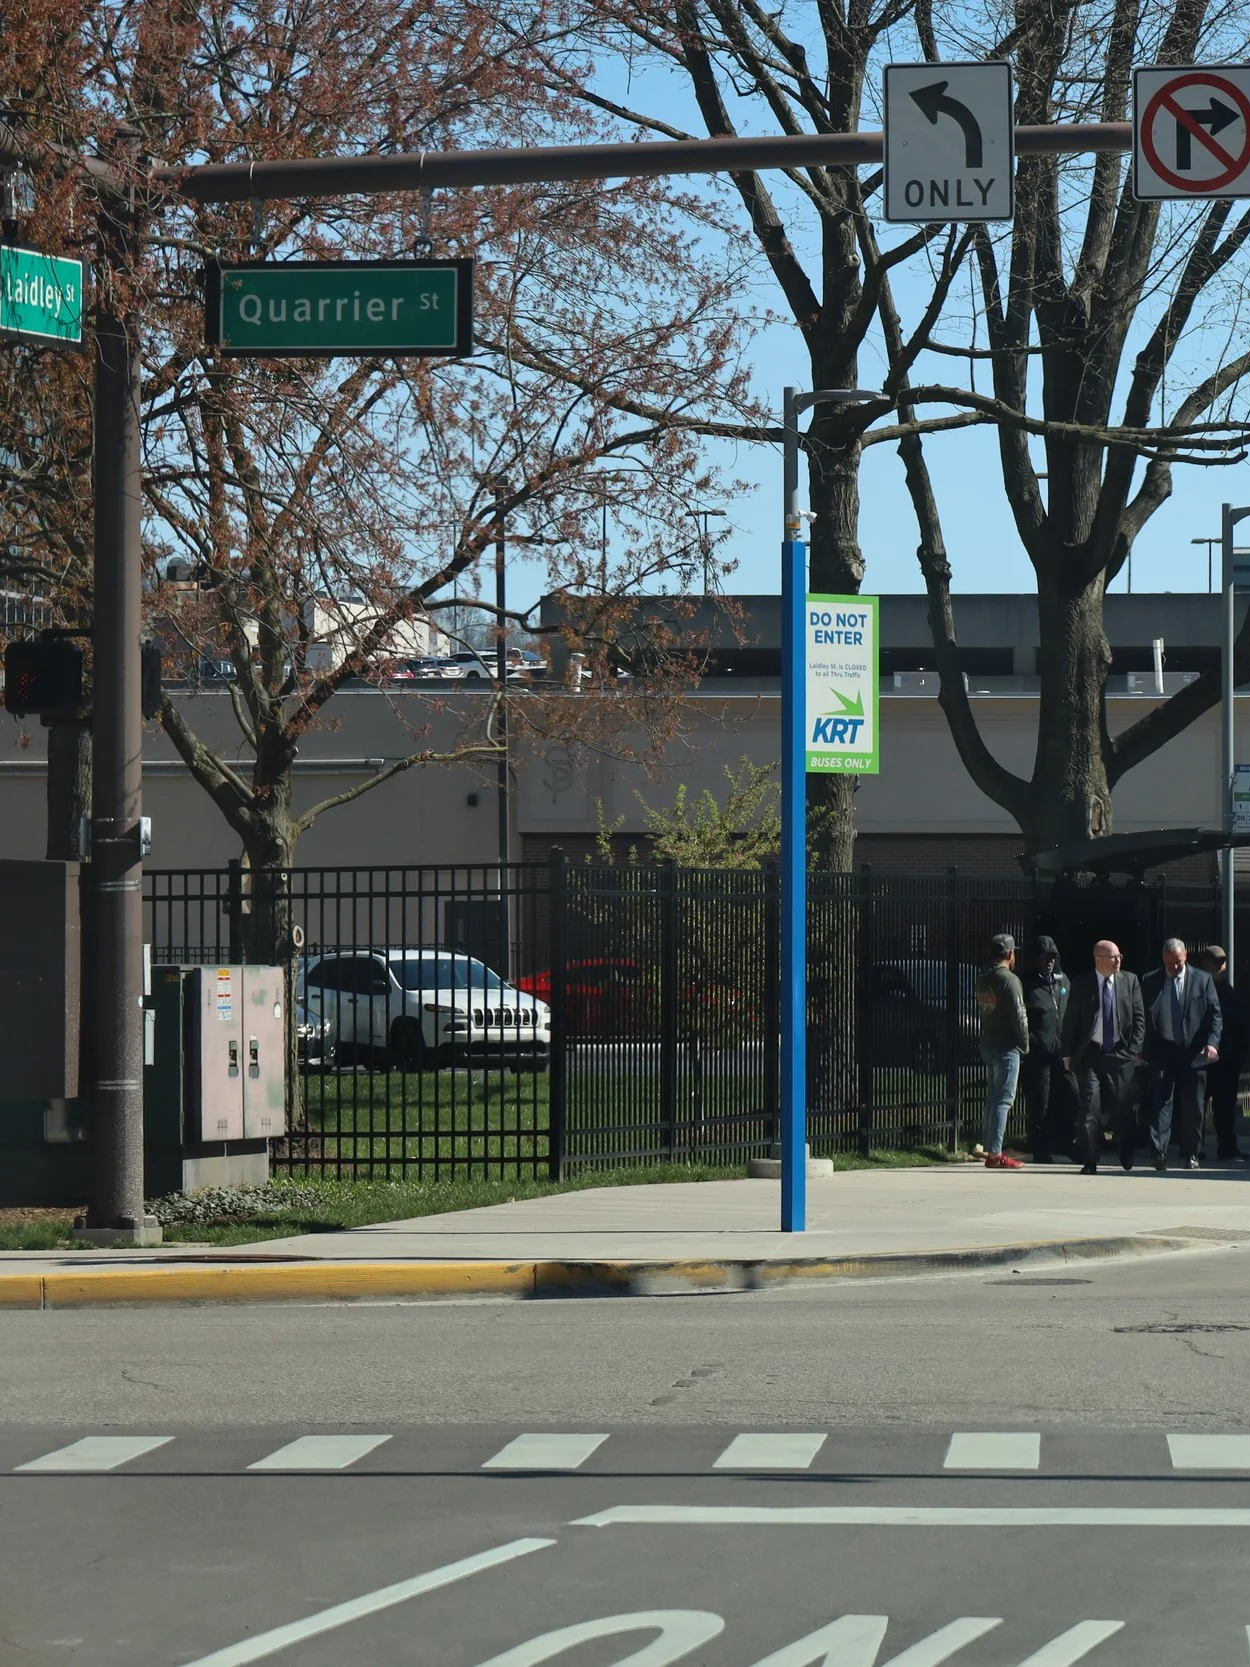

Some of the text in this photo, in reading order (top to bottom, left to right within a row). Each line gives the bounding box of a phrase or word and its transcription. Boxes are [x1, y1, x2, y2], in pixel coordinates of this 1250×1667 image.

[904, 178, 995, 208] ONLY
[7, 272, 75, 318] Laidley St
[239, 291, 439, 325] Quarrier St
[810, 611, 867, 628] DO NOT
[814, 630, 862, 645] ENTER
[844, 671, 862, 679] Traffic
[812, 717, 864, 744] KRT
[810, 757, 872, 769] BUSES ONLY
